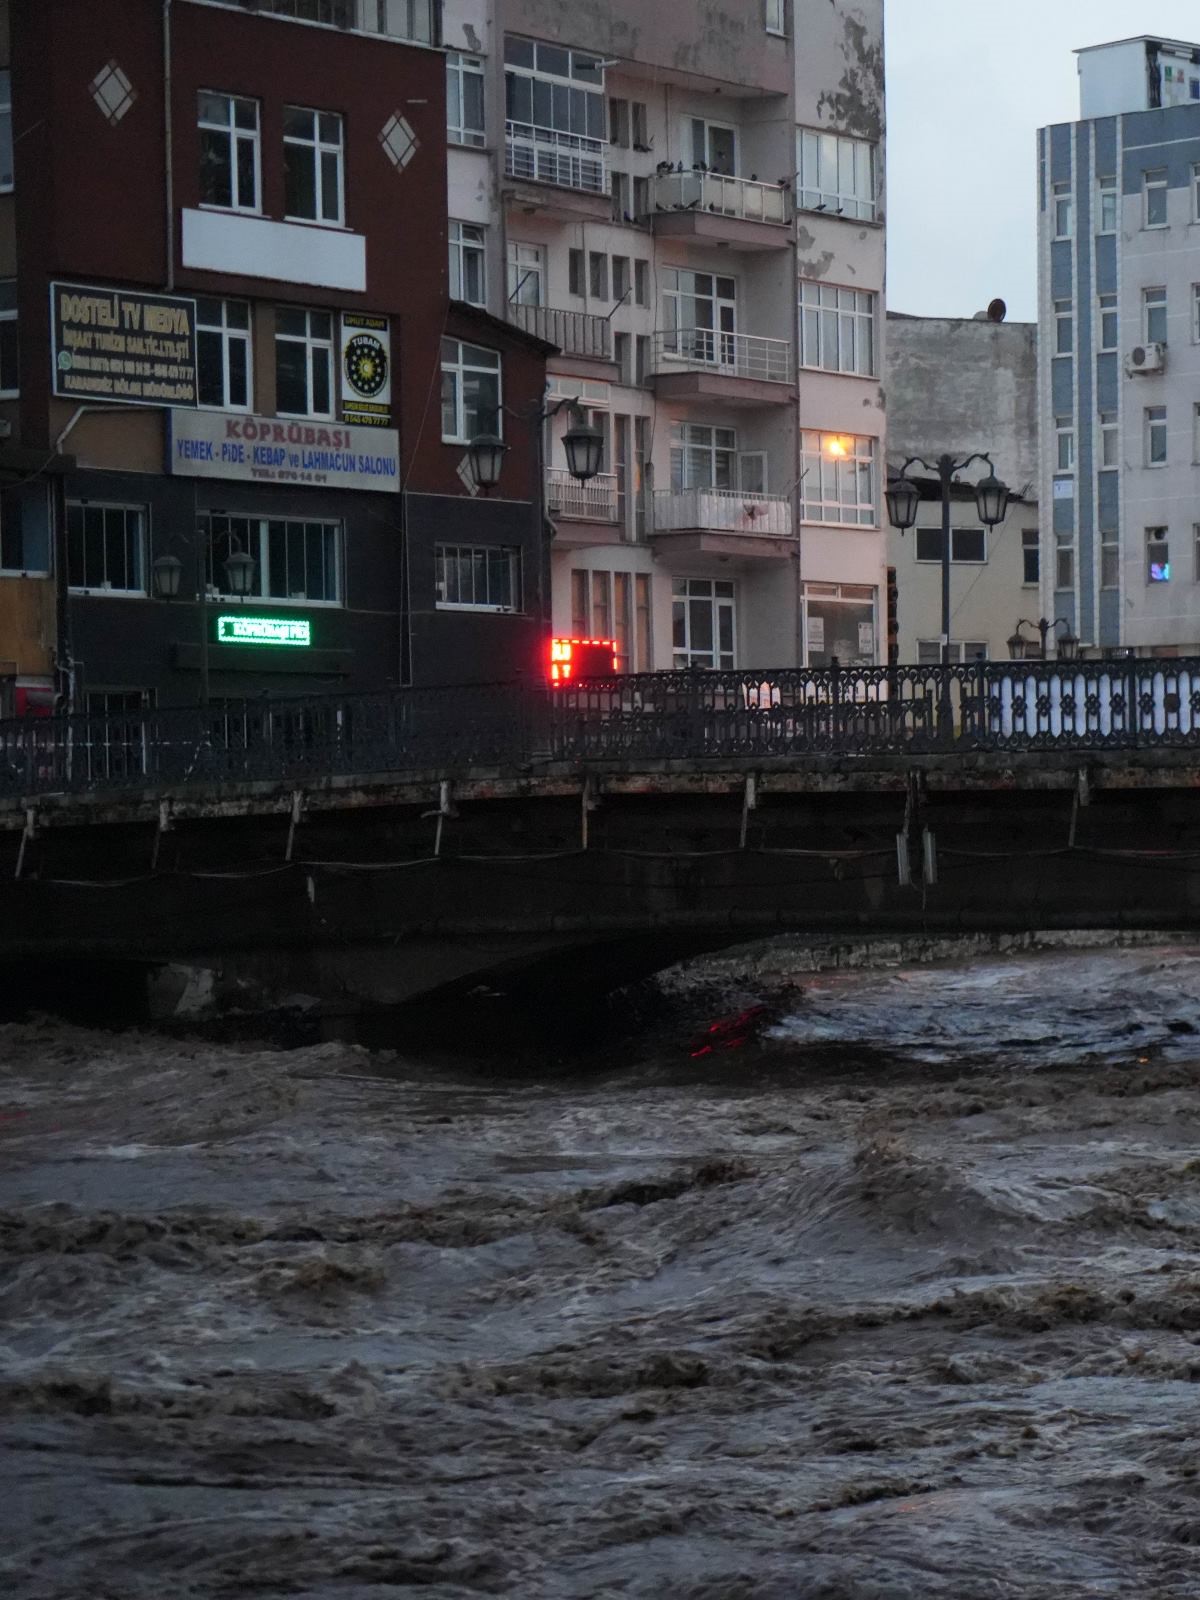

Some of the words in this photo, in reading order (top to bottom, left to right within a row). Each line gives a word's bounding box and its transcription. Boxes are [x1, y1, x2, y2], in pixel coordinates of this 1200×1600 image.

[60, 294, 119, 328] DOSTELİ
[121, 302, 141, 330] TV
[144, 305, 190, 336] MEDYA
[225, 417, 352, 449] KÖPRÜBAŞI
[177, 438, 213, 461] YEMEK
[253, 446, 286, 466] KEBAP
[288, 455, 300, 468] ve
[302, 451, 356, 473] LAHMACUN
[358, 456, 396, 477] SALONU
